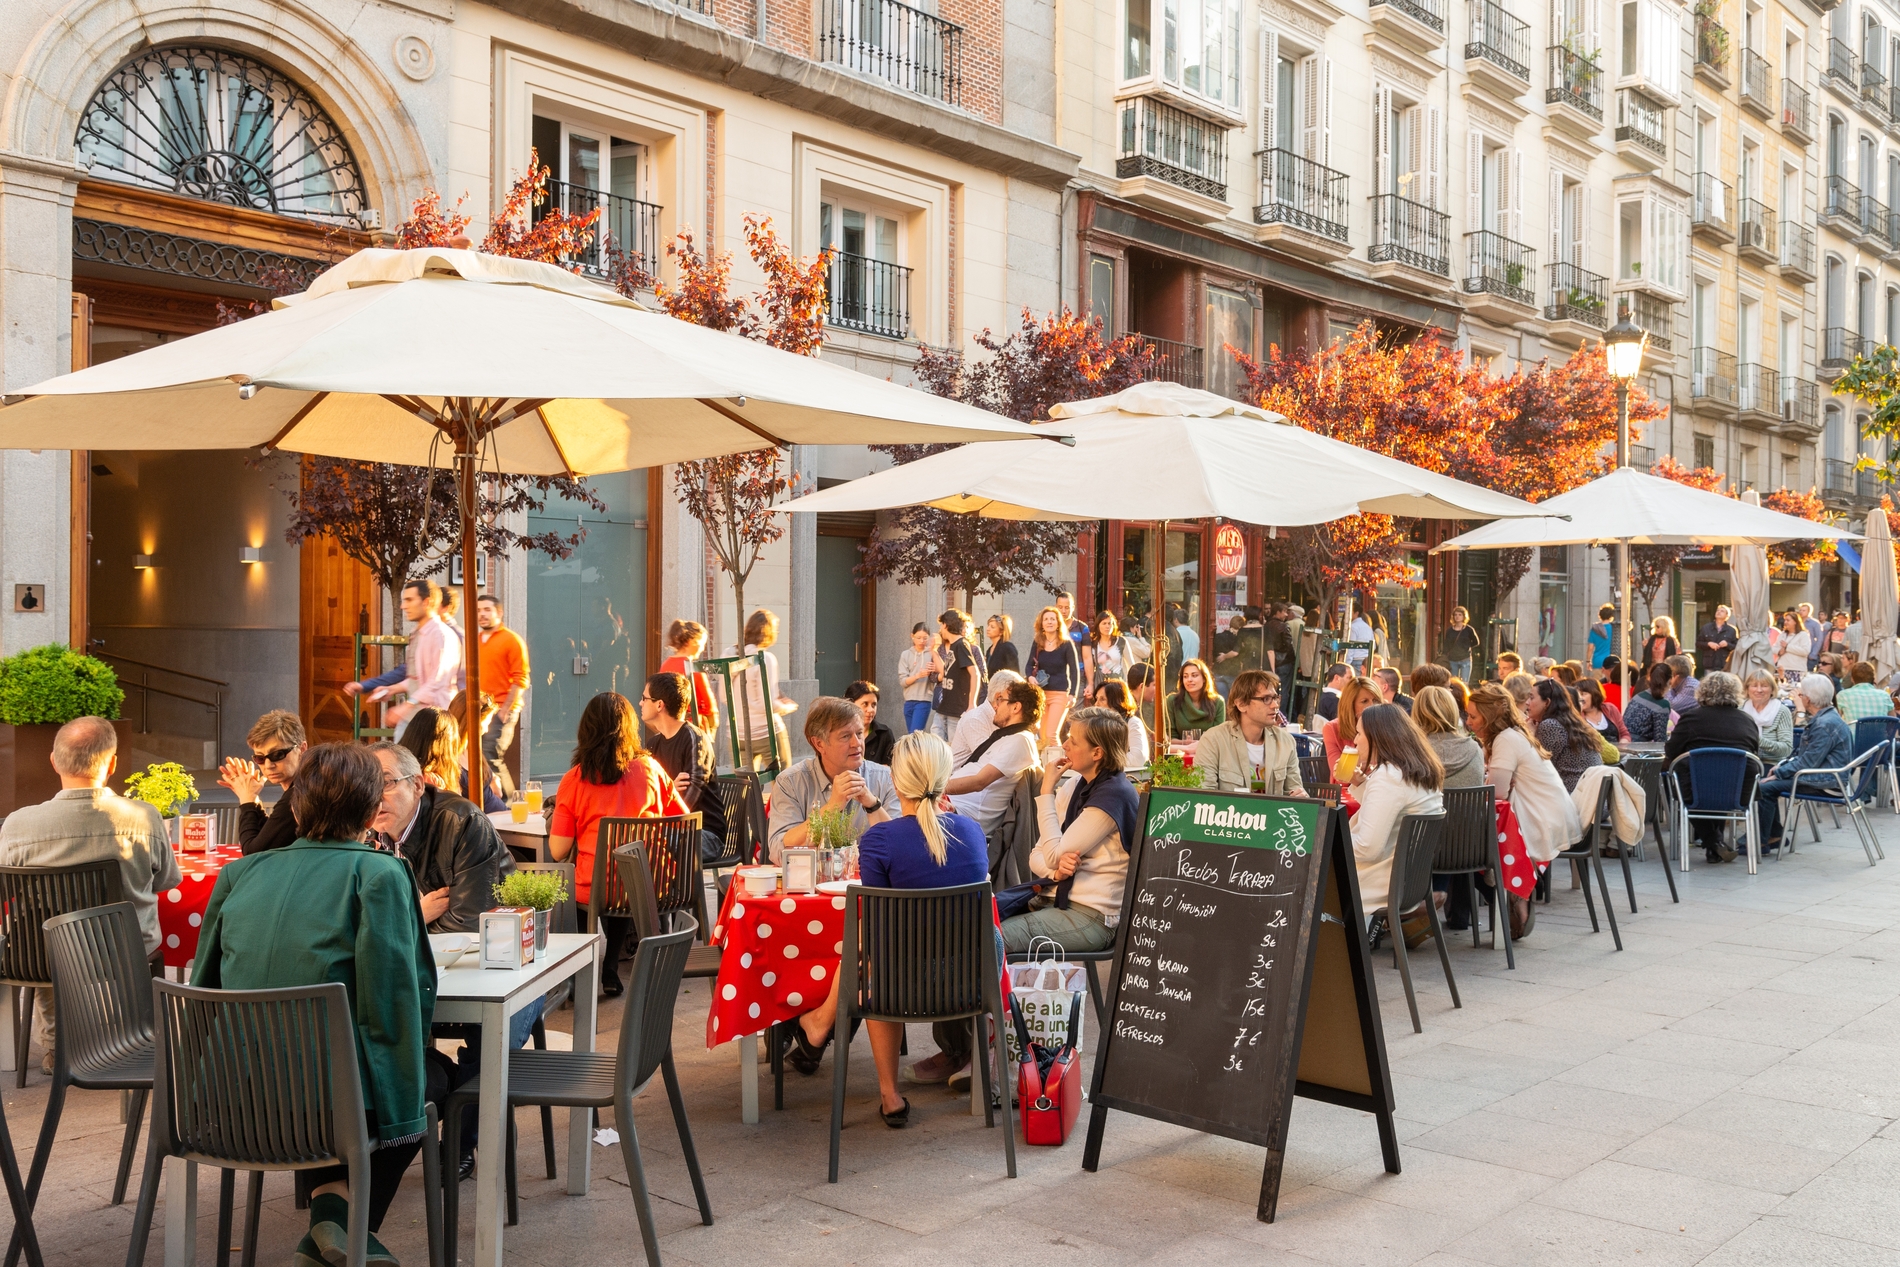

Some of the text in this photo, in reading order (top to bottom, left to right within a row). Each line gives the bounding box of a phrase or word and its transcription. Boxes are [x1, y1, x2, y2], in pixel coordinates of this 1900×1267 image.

[1217, 554, 1242, 571] VIVO
[1149, 800, 1191, 836] ESTADO
[1193, 803, 1267, 831] Mahou
[1154, 832, 1182, 852] PURO
[1204, 828, 1252, 840] CLÁSICA
[1277, 807, 1307, 858] ESTADO
[1272, 828, 1294, 869] PURO
[1132, 913, 1172, 933] CERVEZA
[1266, 909, 1288, 928] 2€
[1157, 953, 1189, 974] VERANO
[1253, 954, 1274, 969] 3€
[1121, 972, 1149, 991] JARRA
[1245, 971, 1266, 988] 3€
[1040, 1003, 1050, 1016] a
[1052, 1000, 1063, 1016] la
[1119, 1001, 1167, 1021] COCKTELES
[1241, 998, 1265, 1018] 15€
[1115, 1019, 1164, 1045] REFRESCOS
[1223, 1054, 1244, 1071] 3€
